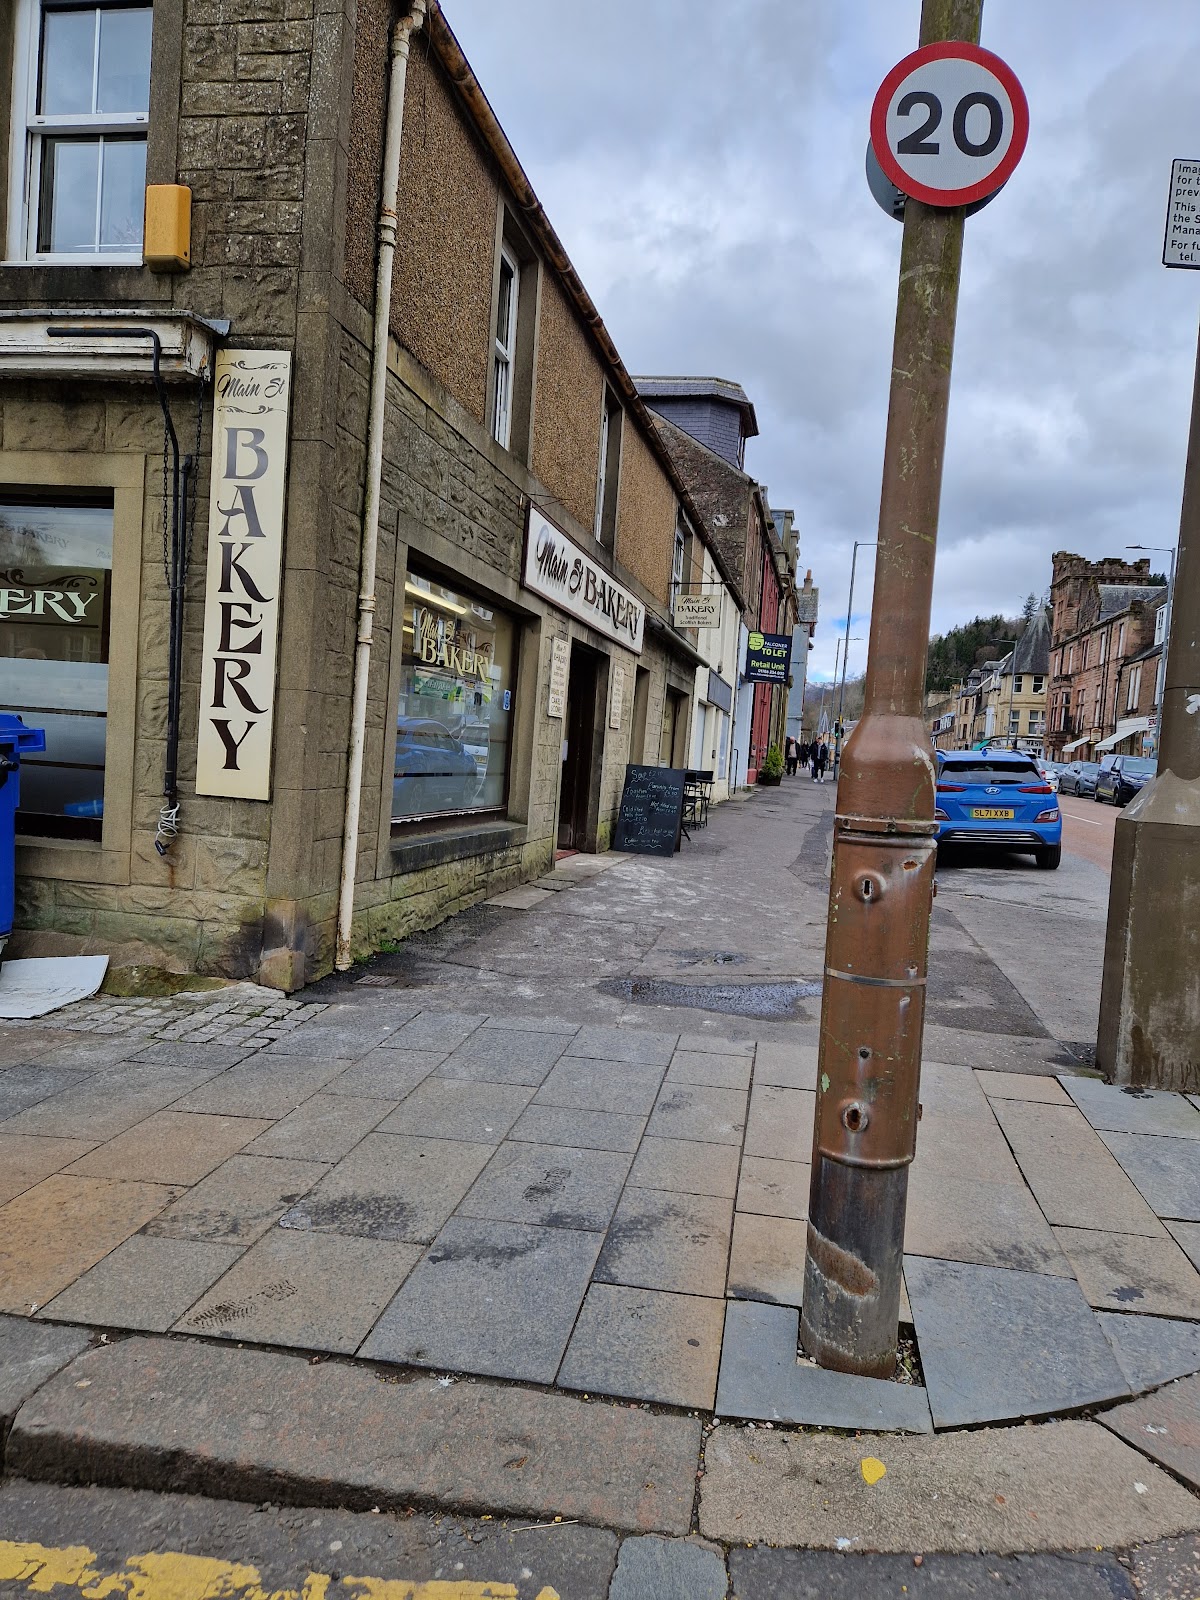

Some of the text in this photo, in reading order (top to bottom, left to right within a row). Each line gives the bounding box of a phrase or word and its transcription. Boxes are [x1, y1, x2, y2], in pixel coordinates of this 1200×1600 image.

[896, 91, 1003, 157] 20
[1177, 175, 1192, 185] for
[1174, 201, 1196, 212] This
[1173, 213, 1190, 223] the
[1171, 239, 1188, 250] For
[1180, 252, 1197, 262] tel.
[216, 373, 285, 399] Main St
[536, 525, 569, 586] Main
[208, 426, 274, 771] BAKERY
[583, 566, 642, 641] BAKERY
[682, 595, 700, 605] Main
[0, 588, 98, 623] ERY
[677, 605, 717, 614] BAKERY
[764, 641, 788, 649] FALCONER
[761, 647, 788, 658] TO LET
[421, 637, 492, 683] BAKERY
[751, 659, 786, 671] Retail Unit
[974, 809, 1010, 817] SL71 XXB
